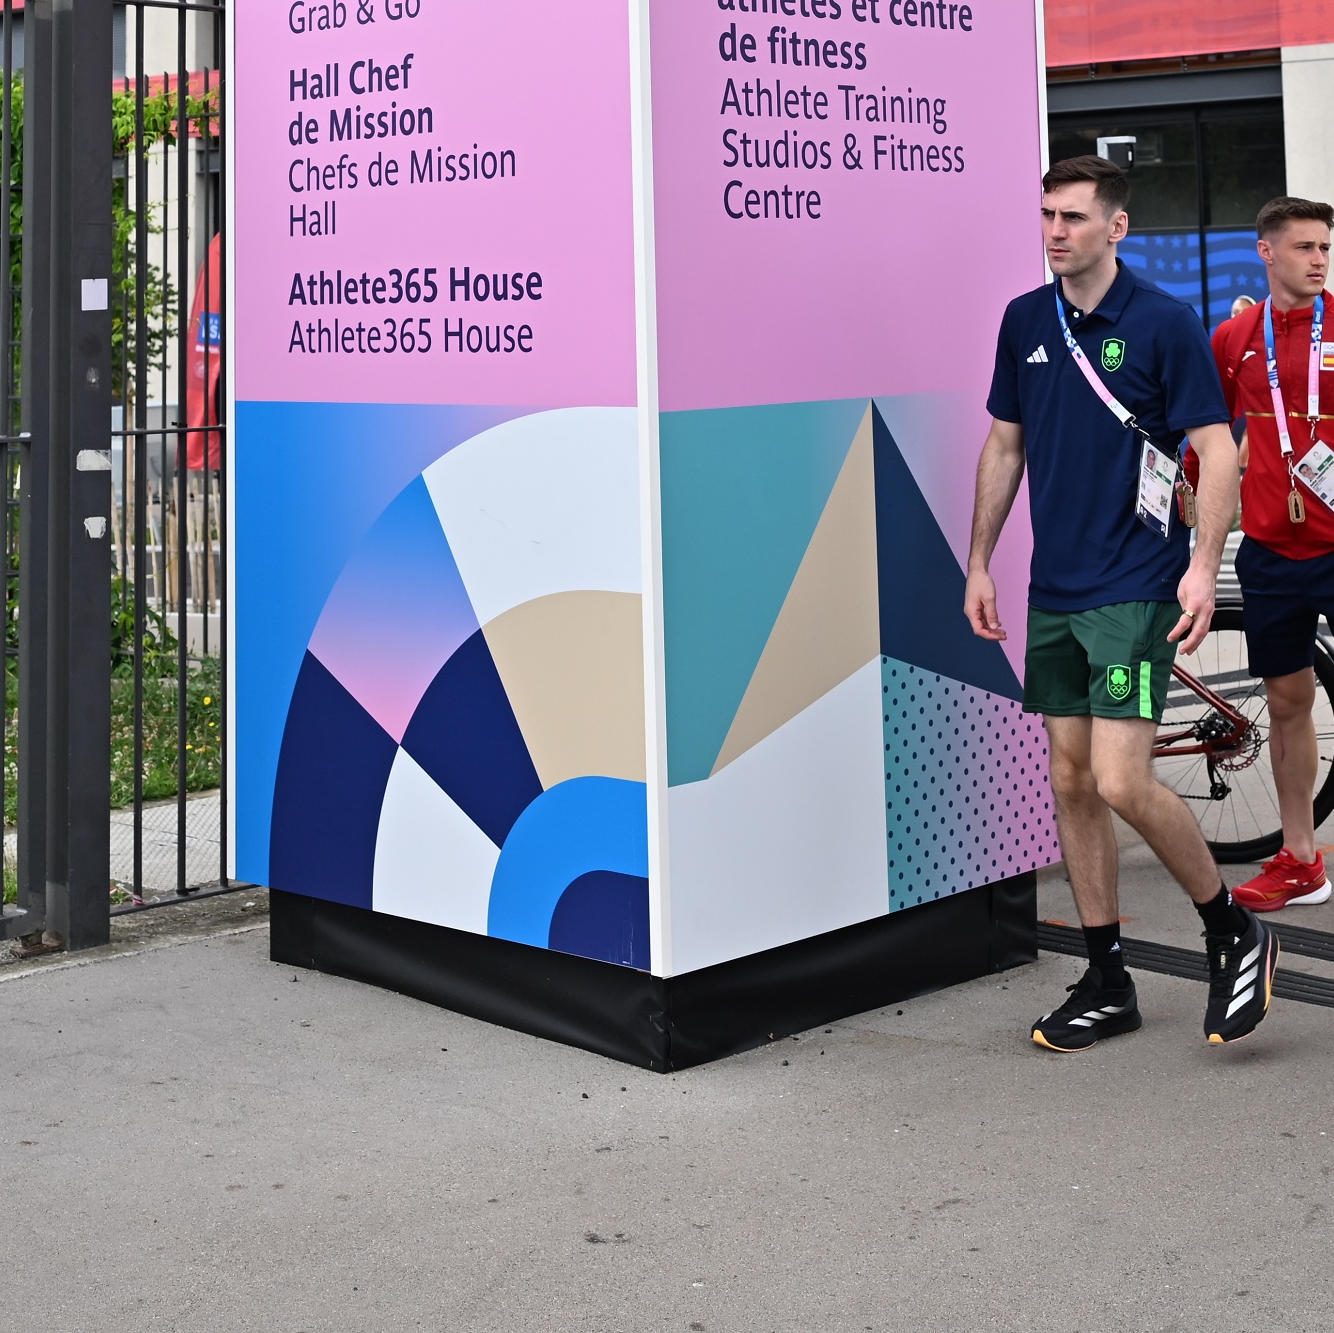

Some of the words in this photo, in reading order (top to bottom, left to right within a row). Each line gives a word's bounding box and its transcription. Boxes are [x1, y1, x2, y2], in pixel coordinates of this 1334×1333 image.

[719, 23, 756, 63] de
[767, 26, 866, 70] fitness
[290, 63, 338, 101] Hall
[350, 53, 414, 94] Chef
[289, 112, 318, 146] de
[330, 101, 432, 142] Mission
[720, 78, 828, 119] Athlete
[838, 85, 947, 134] Training
[289, 154, 358, 192] Chefs
[368, 152, 398, 187] de
[411, 143, 515, 183] Mission
[723, 129, 831, 169] Studios
[843, 133, 863, 170] &
[874, 134, 964, 172] Fitness
[290, 201, 335, 236] Hall
[724, 180, 821, 219] Centre
[289, 268, 437, 305] Athlete365
[450, 267, 542, 301] House
[289, 318, 431, 353] Athlete365
[445, 318, 532, 353] House
